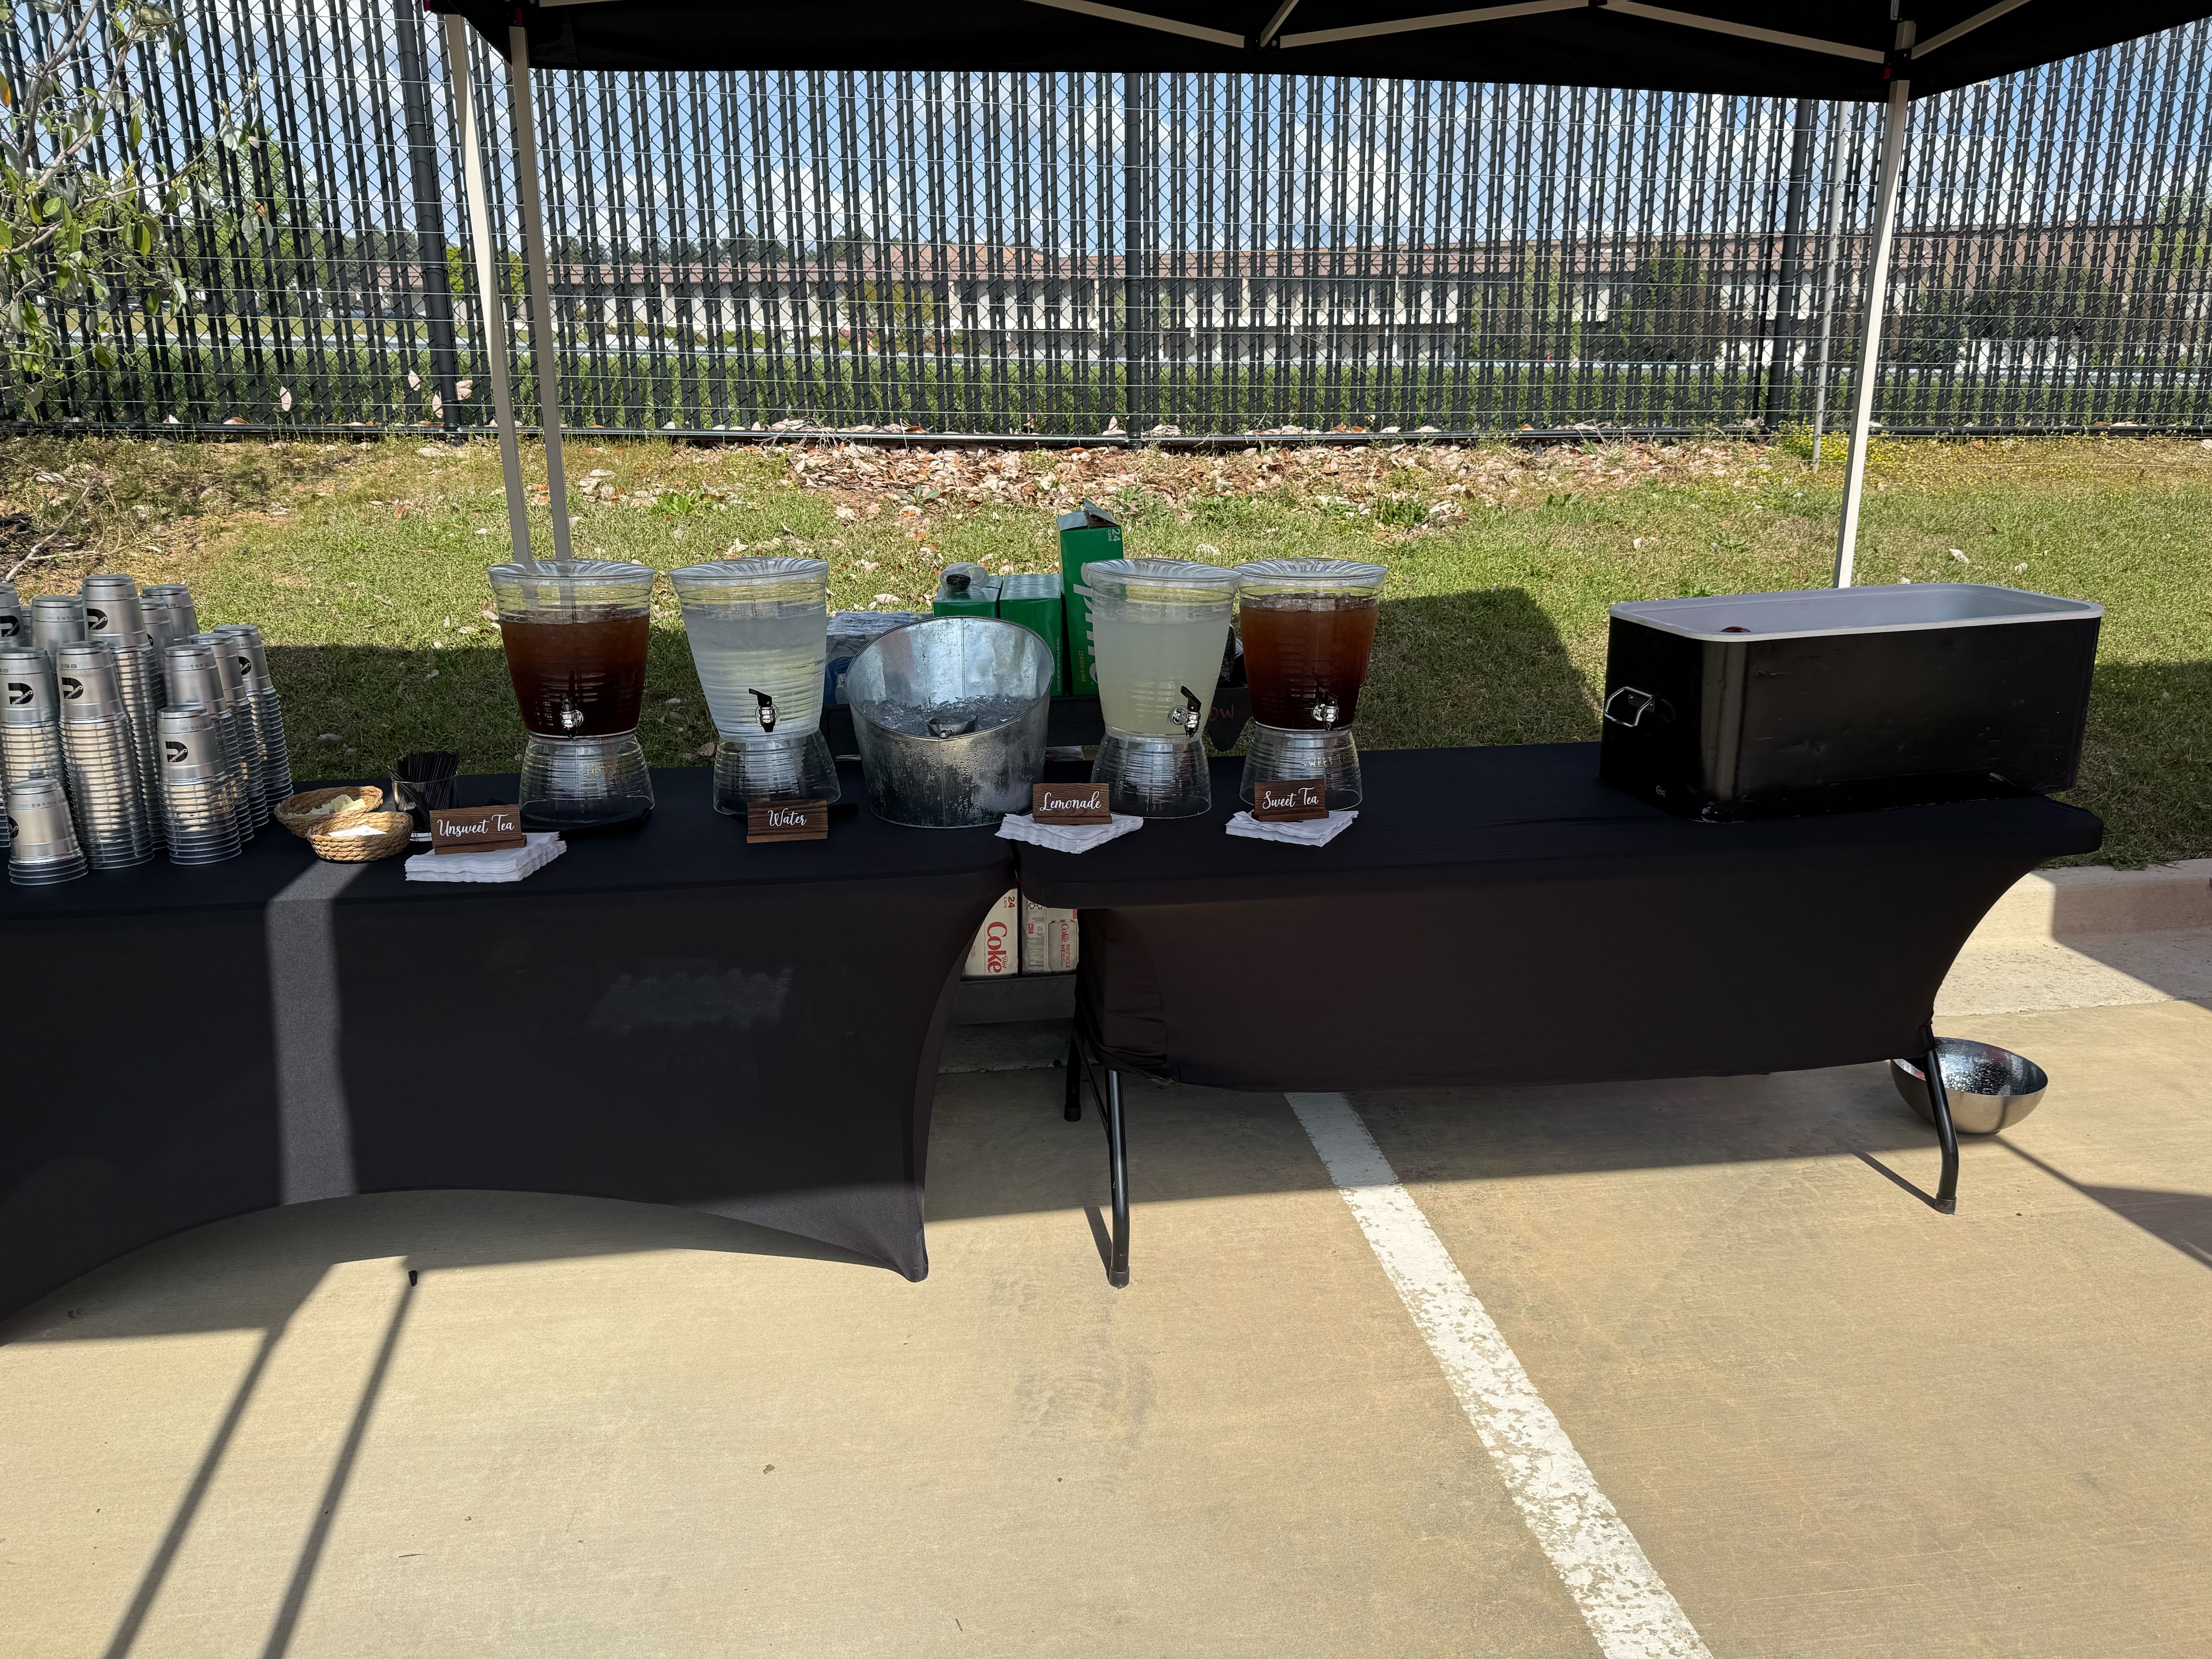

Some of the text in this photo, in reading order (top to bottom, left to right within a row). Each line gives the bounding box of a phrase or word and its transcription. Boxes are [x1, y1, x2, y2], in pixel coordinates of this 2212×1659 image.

[1112, 528, 1121, 541] 24
[1078, 650, 1086, 682] LEMON-LIME
[12, 690, 33, 704] Cummins
[65, 685, 83, 699] Cummins
[169, 748, 187, 762] Cummins
[1039, 791, 1102, 811] Lemonade
[1262, 787, 1319, 809] Sweet Tea
[437, 813, 514, 837] Unsweet Tea
[767, 808, 808, 827] Water
[1008, 896, 1015, 908] 24
[1061, 923, 1069, 942] Coke
[987, 922, 1007, 974] Coke
[1060, 944, 1065, 953] ME
